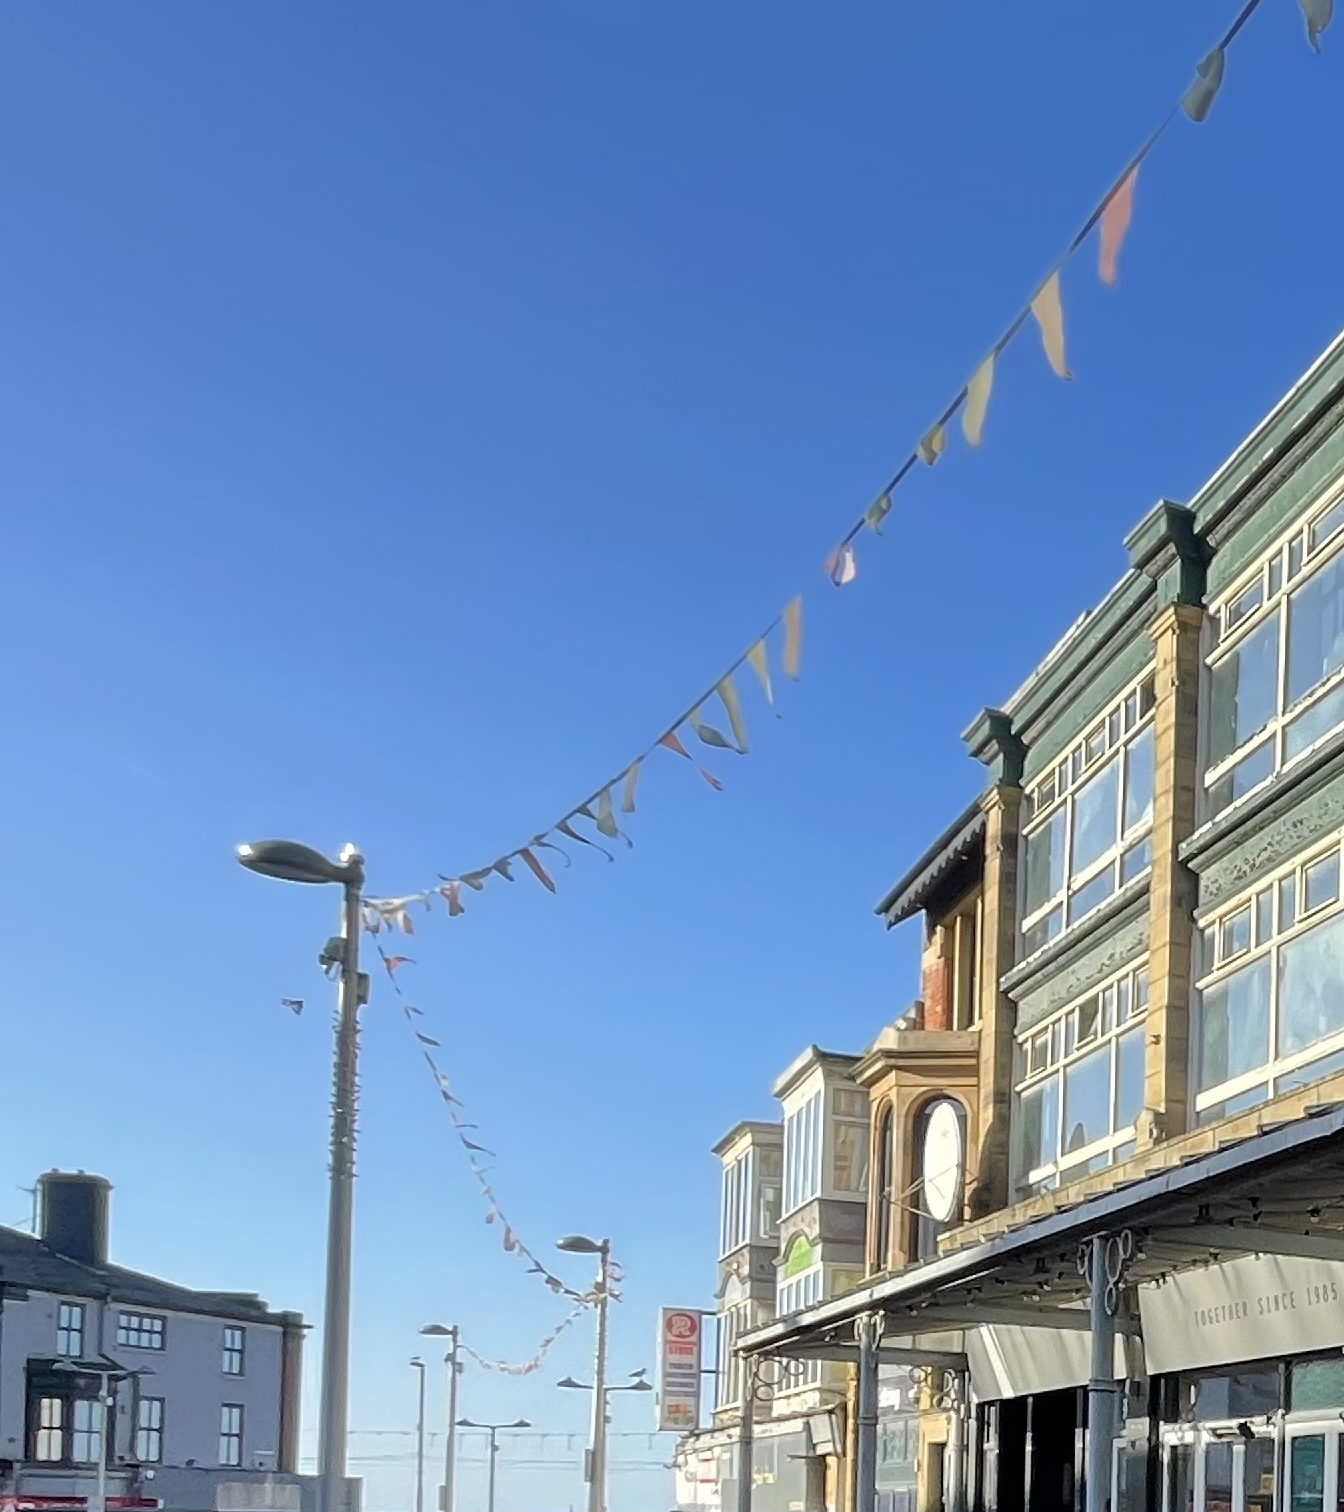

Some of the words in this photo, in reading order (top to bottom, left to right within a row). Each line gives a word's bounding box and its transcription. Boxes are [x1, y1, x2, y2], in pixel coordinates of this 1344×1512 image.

[1194, 1301, 1249, 1329] TOGETHER
[1257, 1290, 1297, 1316] SINCE
[1306, 1281, 1338, 1306] 1985
